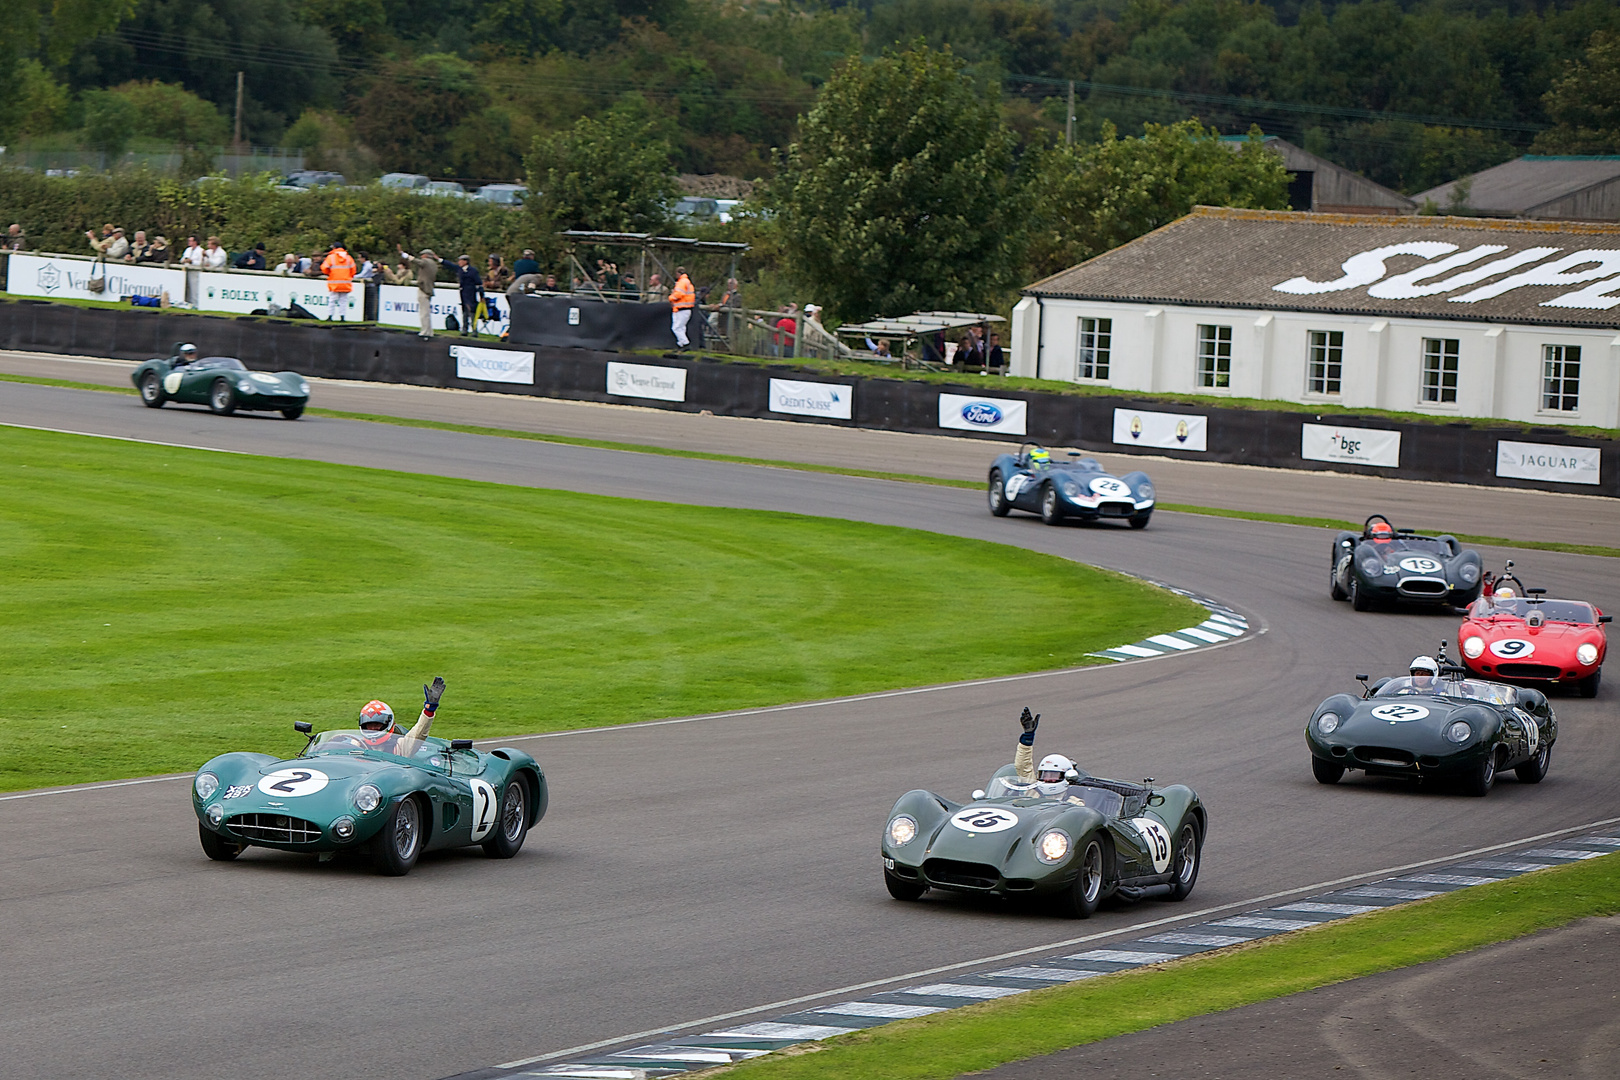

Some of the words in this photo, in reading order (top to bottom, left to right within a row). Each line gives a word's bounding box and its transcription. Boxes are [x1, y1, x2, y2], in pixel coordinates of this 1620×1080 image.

[221, 289, 258, 302] ROLEX
[394, 302, 440, 315] WILLIS
[807, 398, 831, 411] SUISSE
[967, 405, 997, 423] Ford
[1341, 436, 1361, 454] bgc
[1520, 454, 1577, 469] JAGUAR
[1100, 480, 1120, 491] 28
[1407, 560, 1435, 569] 19
[1498, 641, 1525, 655] 9
[1378, 705, 1419, 718] 32
[269, 771, 312, 793] 2
[476, 785, 489, 832] 2
[958, 811, 1011, 828] 15
[1145, 825, 1167, 861] 15
